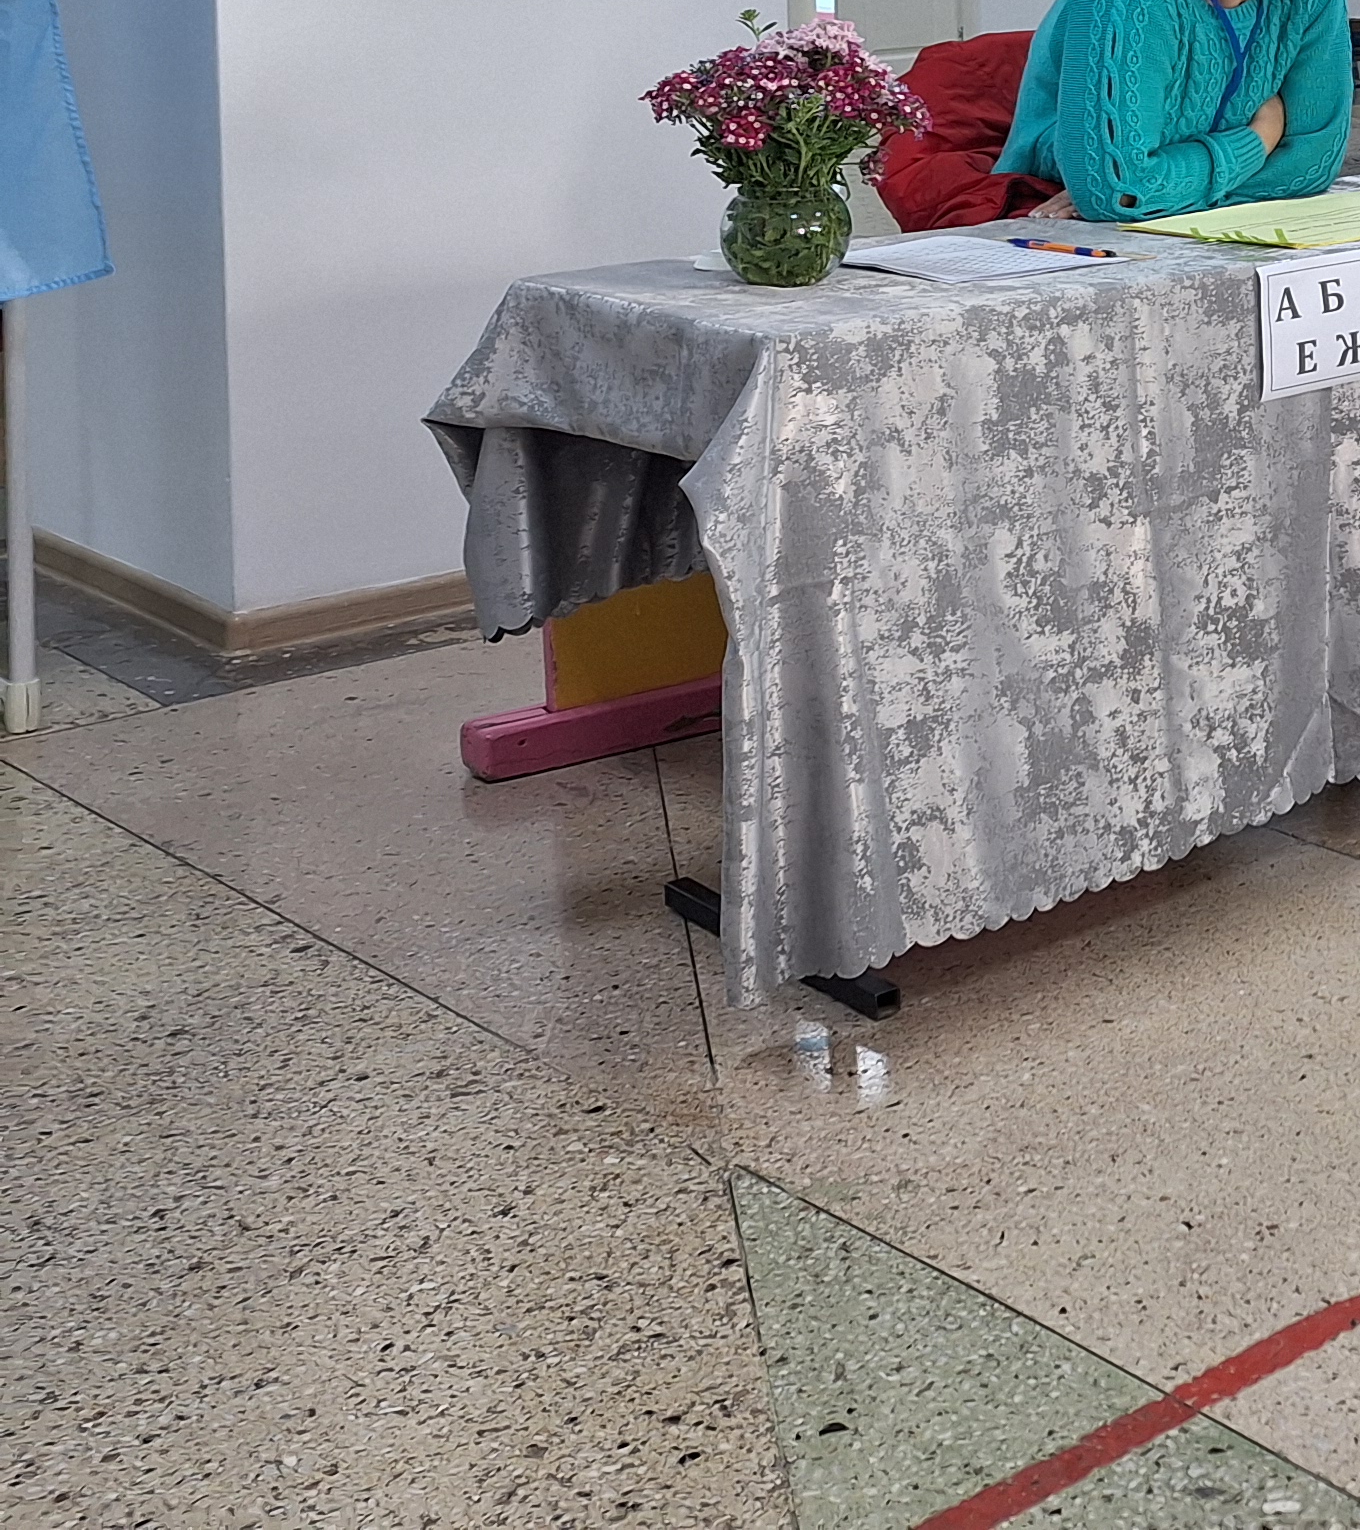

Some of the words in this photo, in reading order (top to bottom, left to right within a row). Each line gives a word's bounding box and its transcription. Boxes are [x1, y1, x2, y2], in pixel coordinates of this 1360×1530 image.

[1275, 287, 1302, 322] А
[1318, 278, 1344, 314] Б
[1296, 339, 1317, 375] Е
